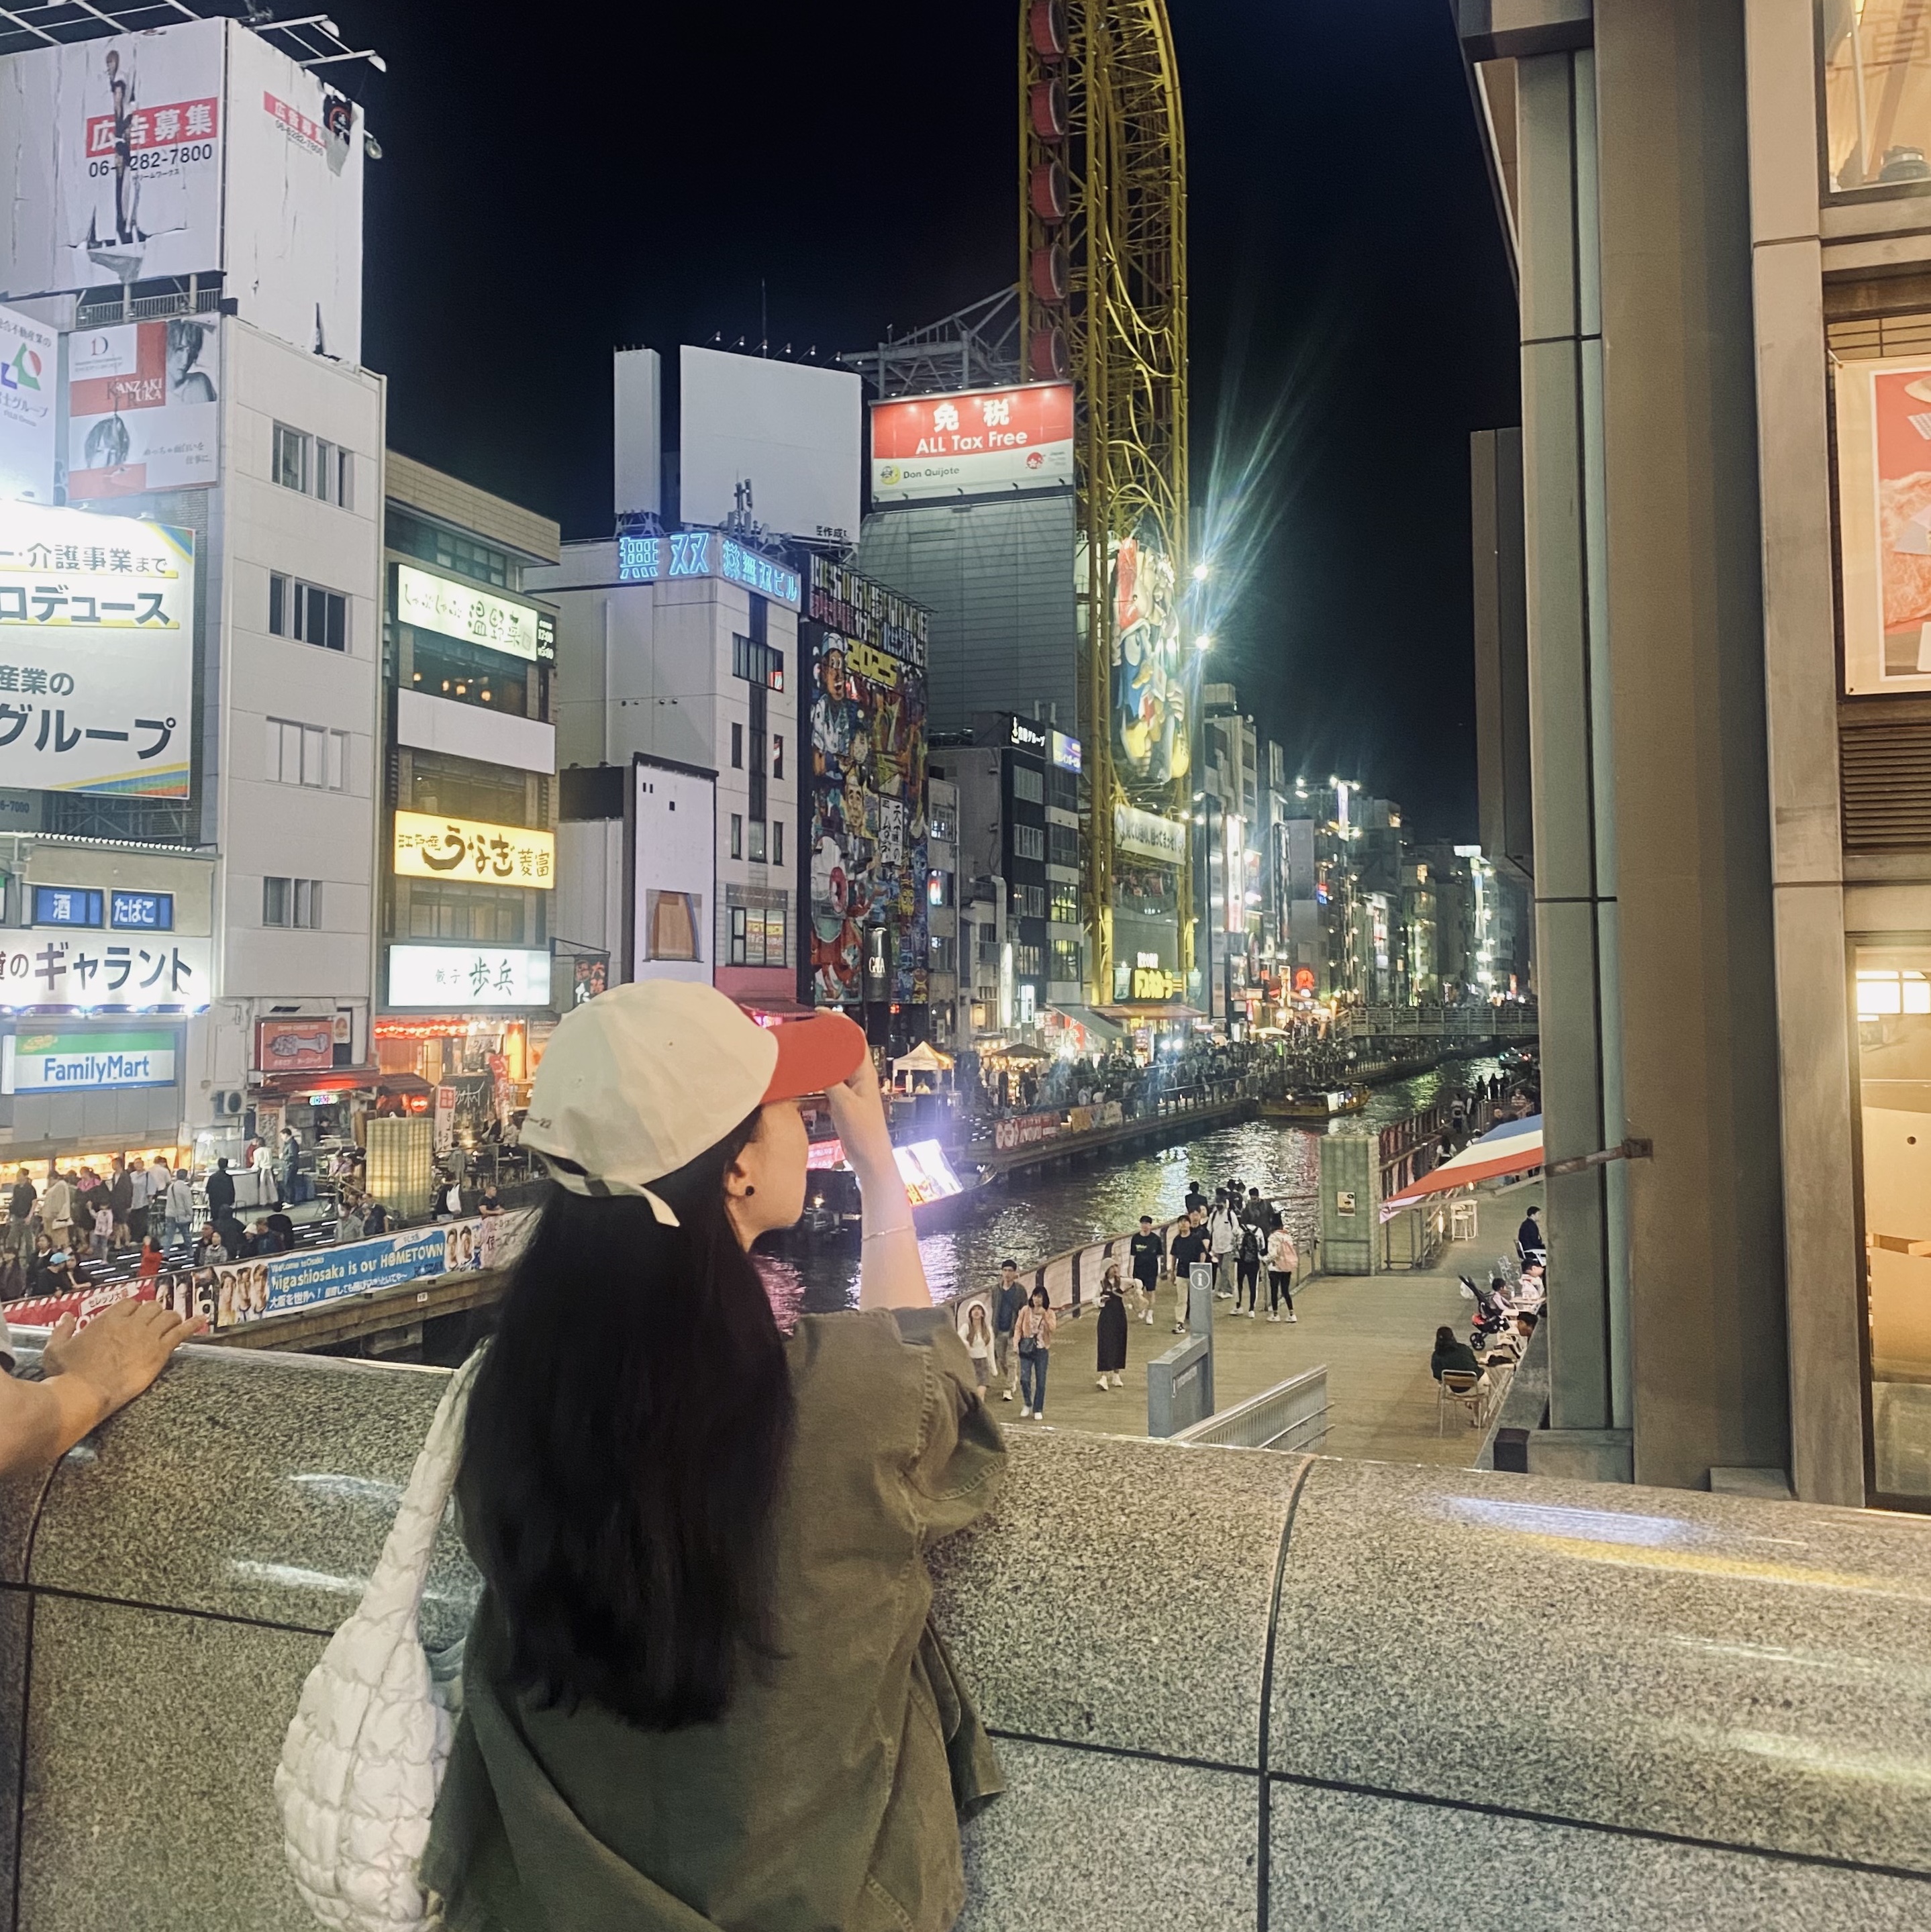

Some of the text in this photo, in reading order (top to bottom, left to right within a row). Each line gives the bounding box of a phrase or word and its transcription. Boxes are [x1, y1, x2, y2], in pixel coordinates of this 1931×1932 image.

[89, 144, 212, 177] 06-282-7800
[915, 430, 1028, 455] ALL Tax Free
[903, 466, 960, 479] Don Quijote
[422, 825, 515, 877] うなぎ
[517, 848, 550, 877] 菱富
[52, 893, 71, 920] 酒
[113, 897, 154, 923] たばこ
[468, 956, 514, 997] 歩兵
[44, 1055, 149, 1082] FamilyMart
[348, 1261, 357, 1275] is
[360, 1259, 377, 1273] our
